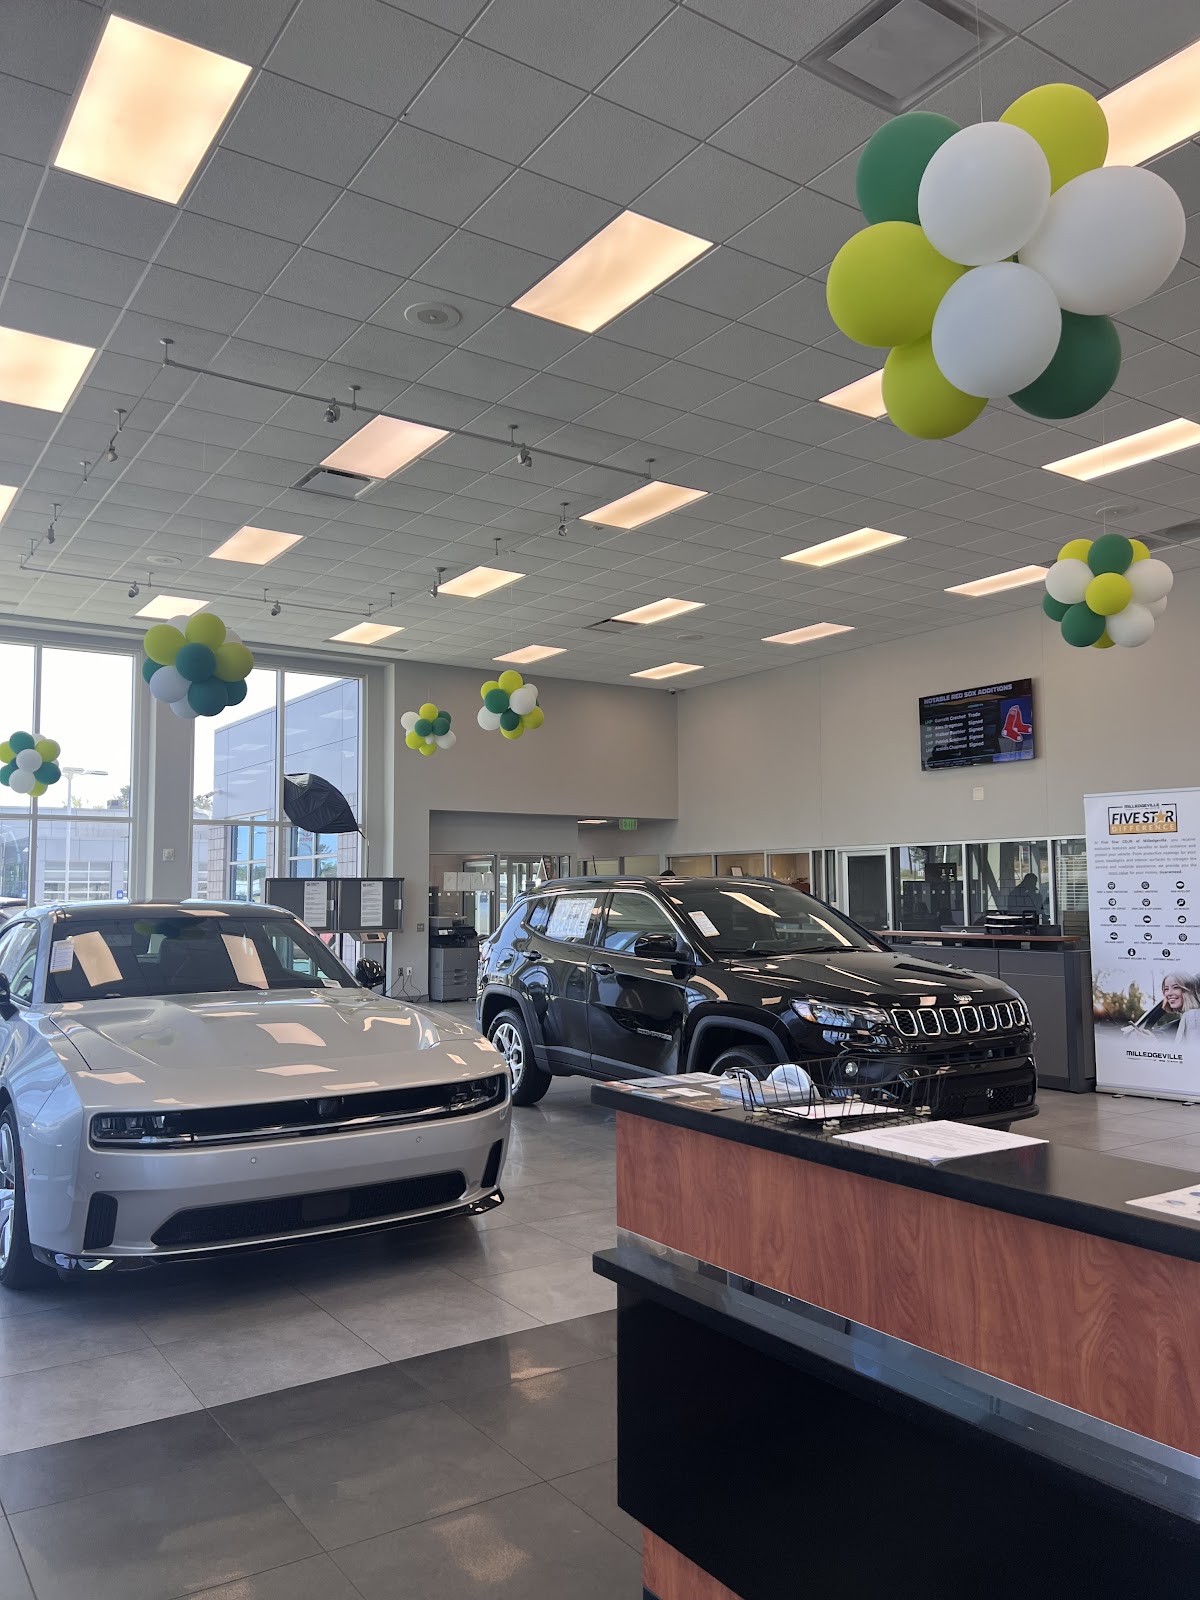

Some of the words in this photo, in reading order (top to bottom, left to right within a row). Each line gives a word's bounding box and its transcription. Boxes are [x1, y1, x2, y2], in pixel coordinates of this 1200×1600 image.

[924, 695, 950, 704] NOTABLE
[978, 684, 1013, 695] ADDITIONS
[1112, 812, 1140, 824] FIVE
[1111, 823, 1175, 833] DIFFERENCE
[1126, 1050, 1183, 1060] MILLEDGEVILLE
